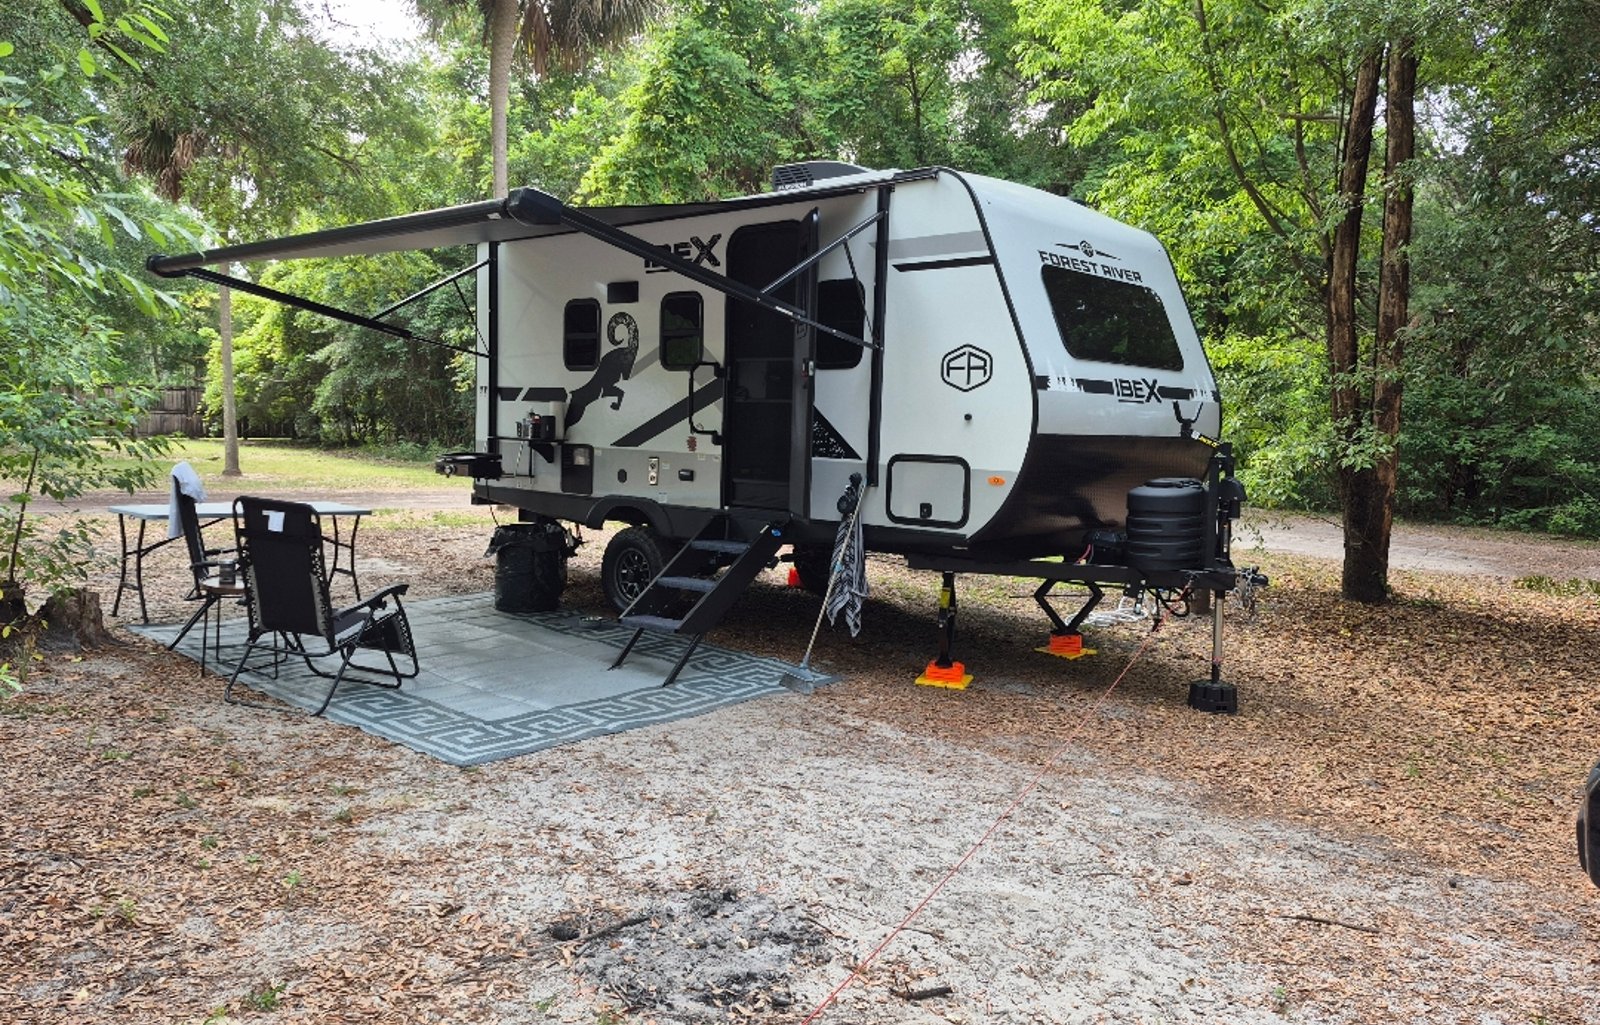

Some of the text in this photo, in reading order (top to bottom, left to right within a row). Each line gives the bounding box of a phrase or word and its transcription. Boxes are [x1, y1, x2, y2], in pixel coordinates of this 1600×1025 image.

[1038, 250, 1143, 283] FOREST RIVER
[1114, 378, 1162, 403] IBEX
